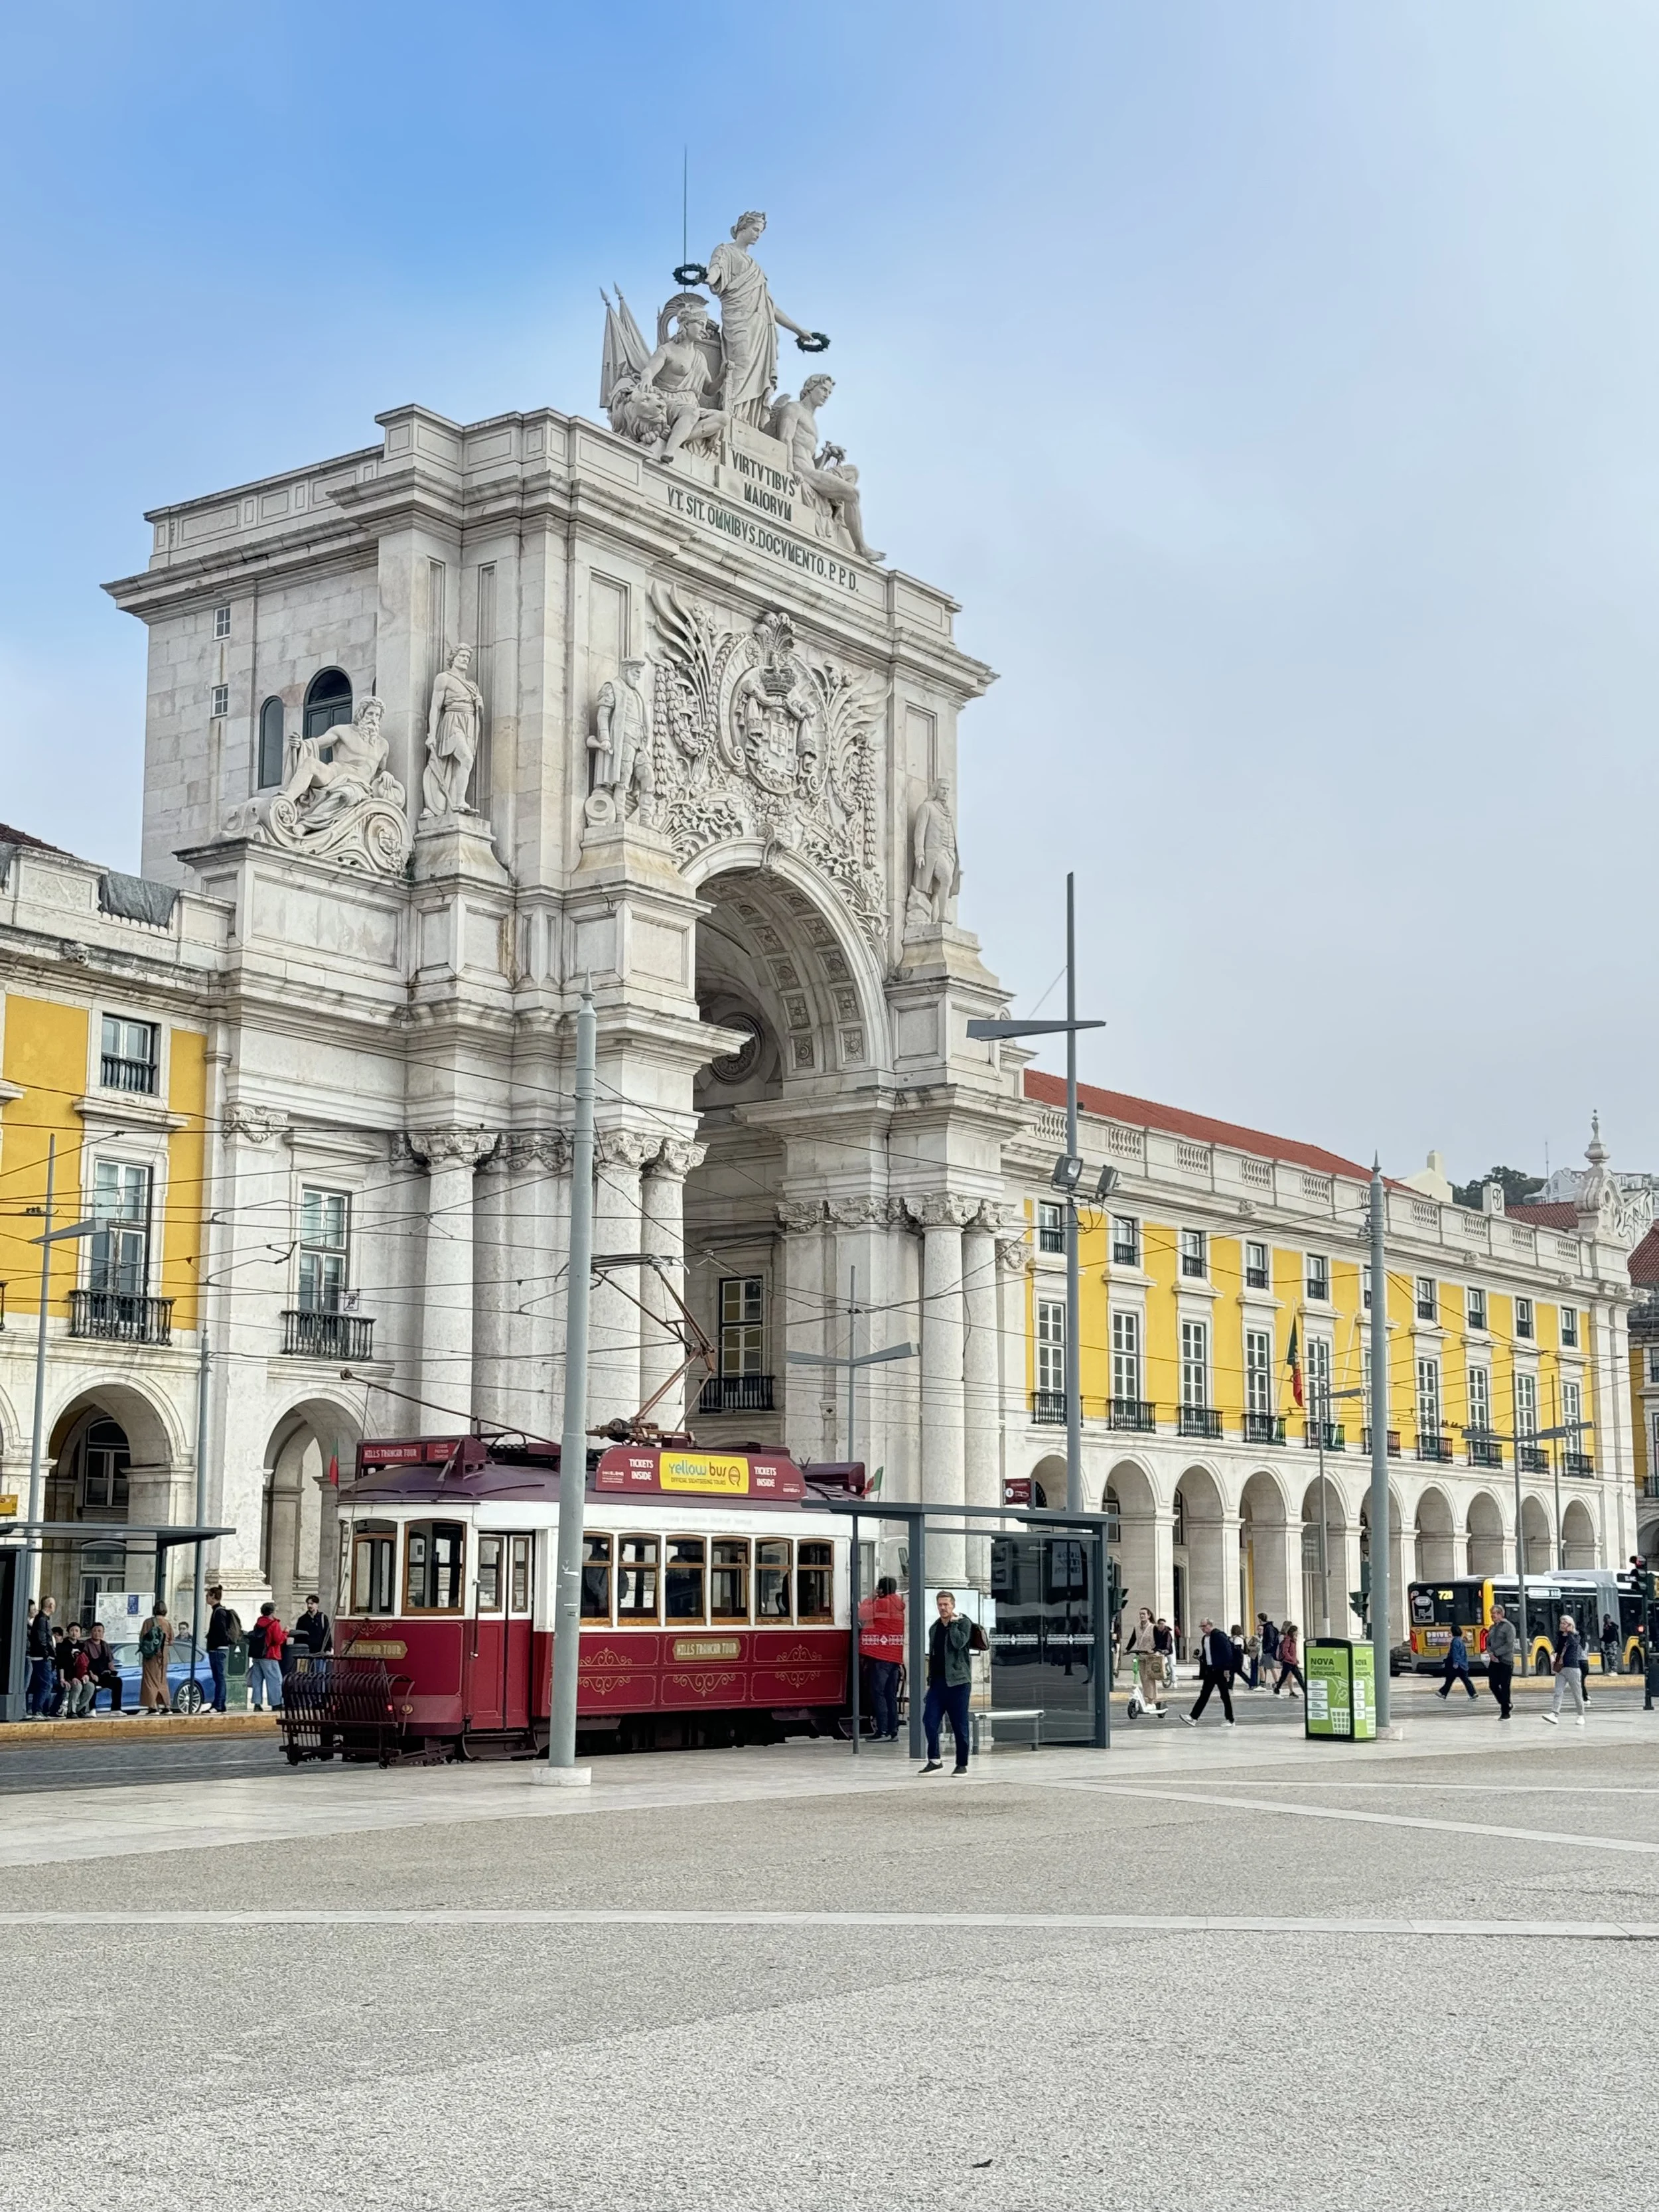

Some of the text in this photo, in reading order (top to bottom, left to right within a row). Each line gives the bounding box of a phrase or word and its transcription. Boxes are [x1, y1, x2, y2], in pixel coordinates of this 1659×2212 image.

[732, 450, 795, 497] VIRTVTIBVS
[744, 482, 792, 522] MAIORVM
[628, 1459, 654, 1469] TICKETS
[709, 1461, 727, 1477] bus
[631, 1471, 652, 1481] INSIDE
[754, 1466, 777, 1476] TICKETS
[757, 1478, 775, 1487] INSIDE
[383, 1645, 401, 1655] TOUR
